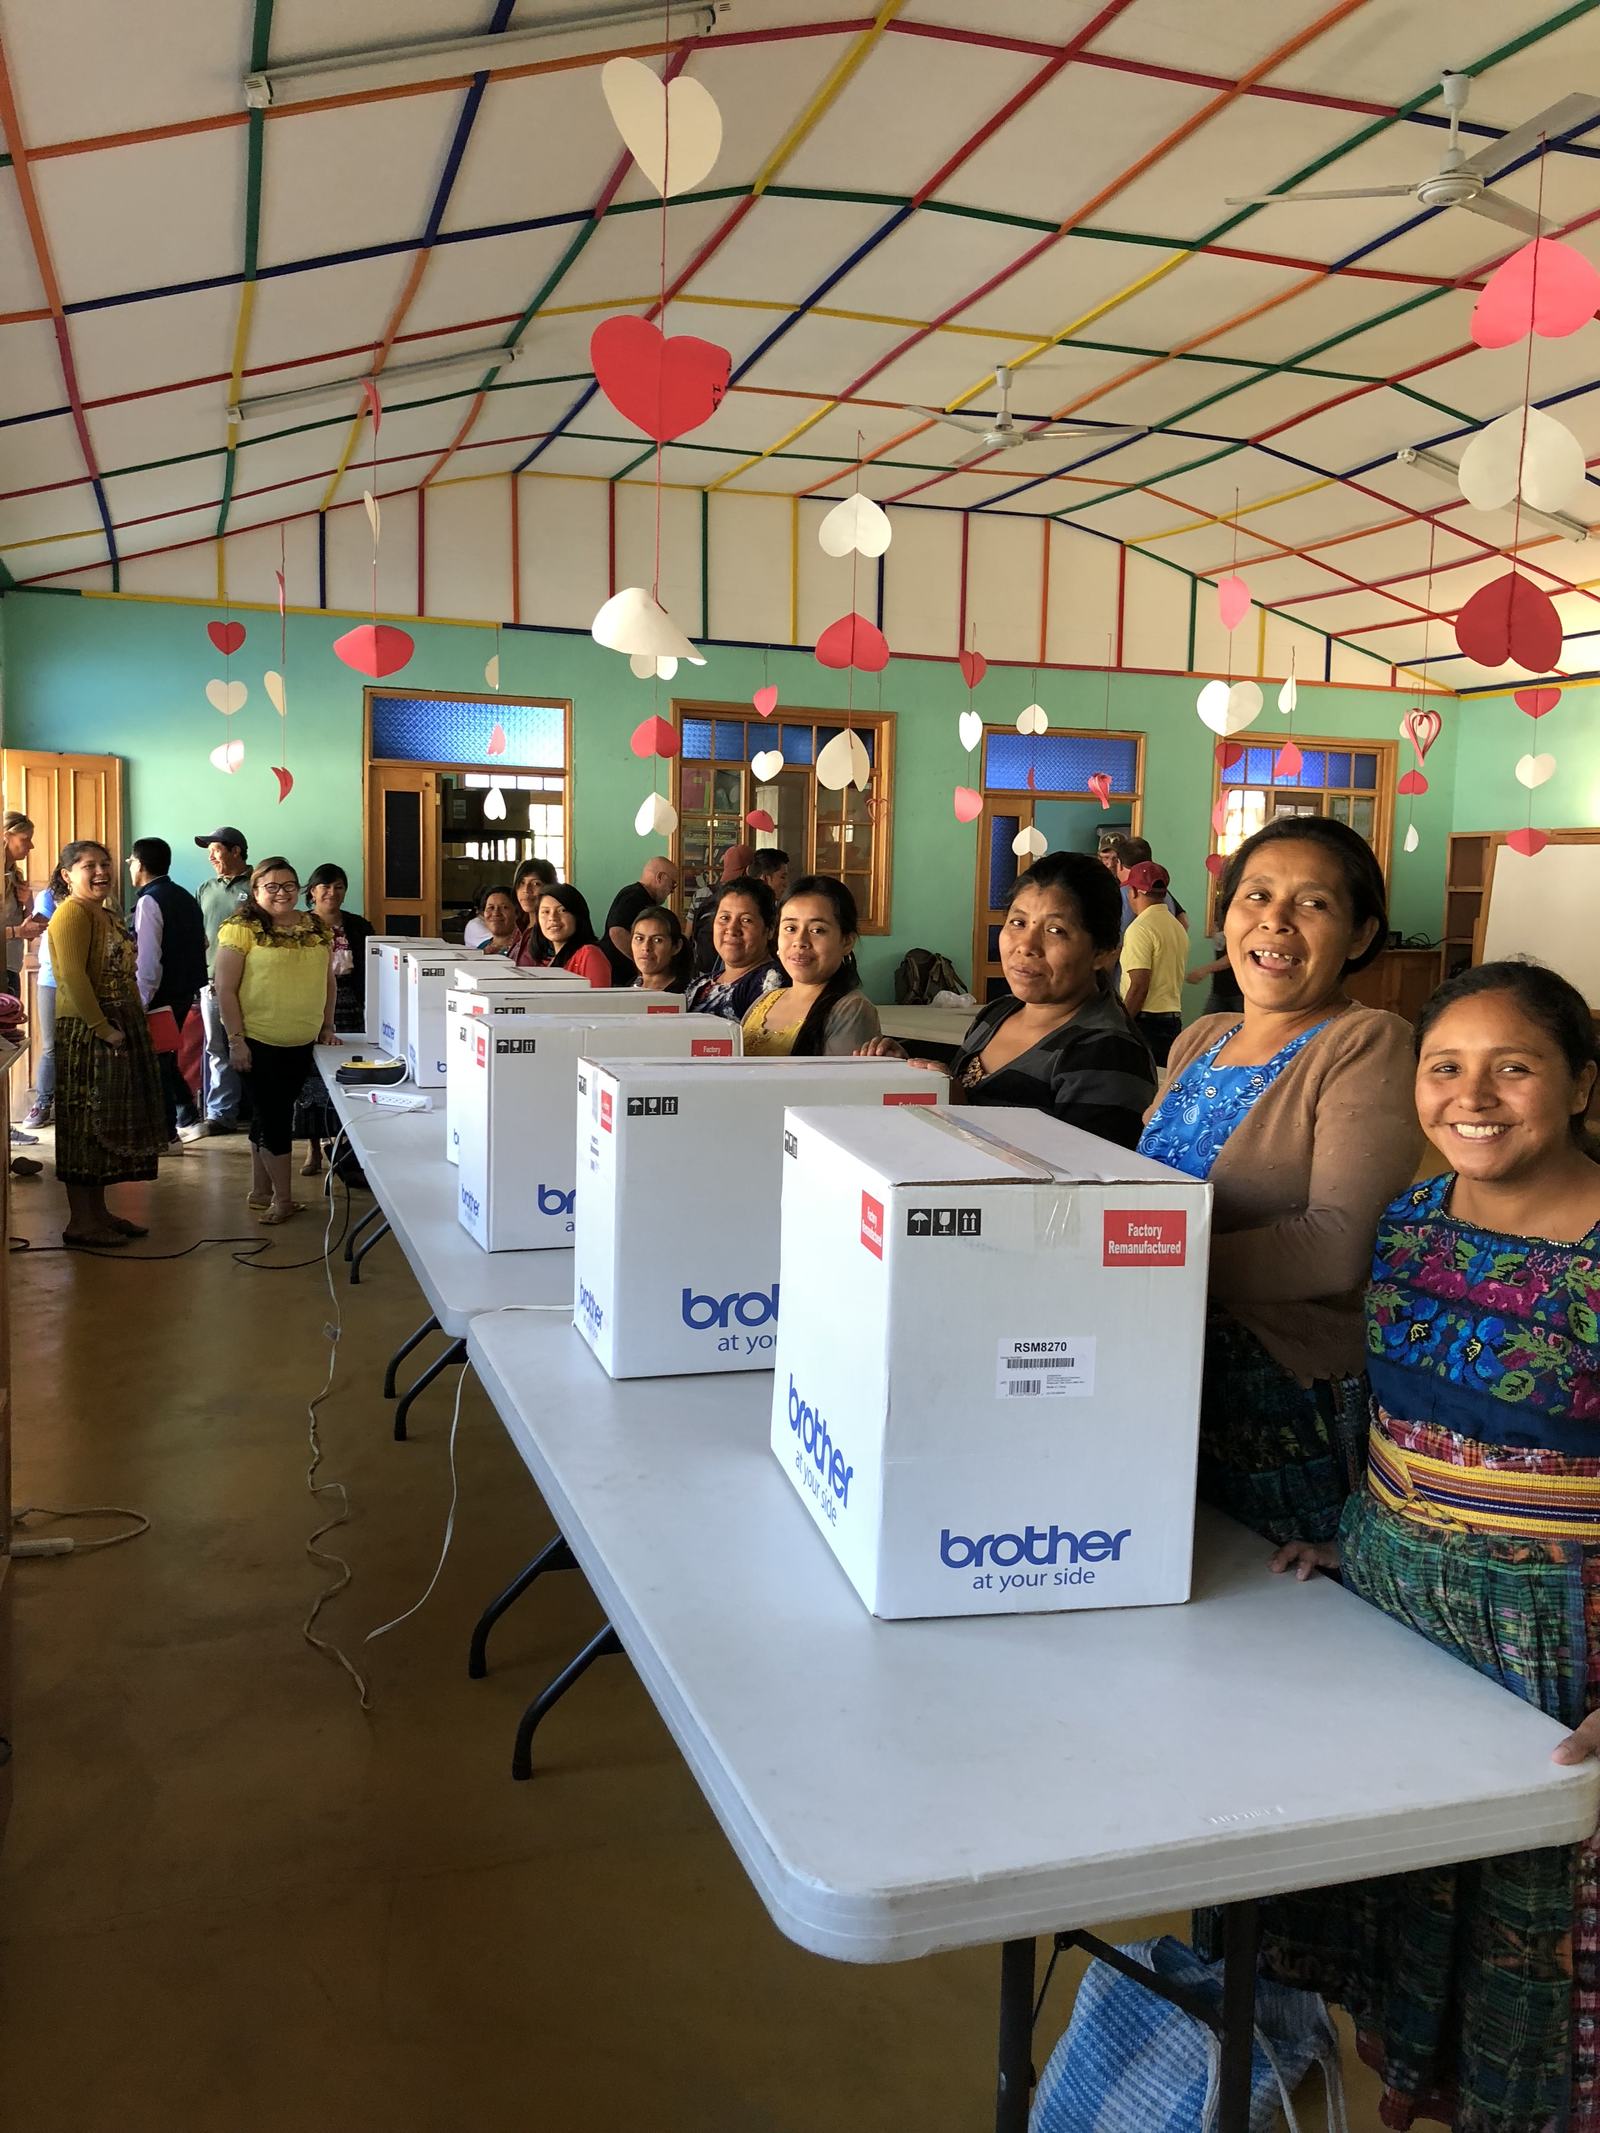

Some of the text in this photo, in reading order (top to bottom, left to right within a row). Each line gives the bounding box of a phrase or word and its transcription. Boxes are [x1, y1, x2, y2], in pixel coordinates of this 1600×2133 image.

[1128, 1222, 1163, 1240] Factory
[1108, 1240, 1182, 1254] Remanufactured
[717, 1334, 778, 1355] at yo
[1014, 1342, 1068, 1353] RSM8270
[788, 1372, 854, 1509] brother
[939, 1524, 1132, 1569] brother
[973, 1567, 1096, 1593] at your side
